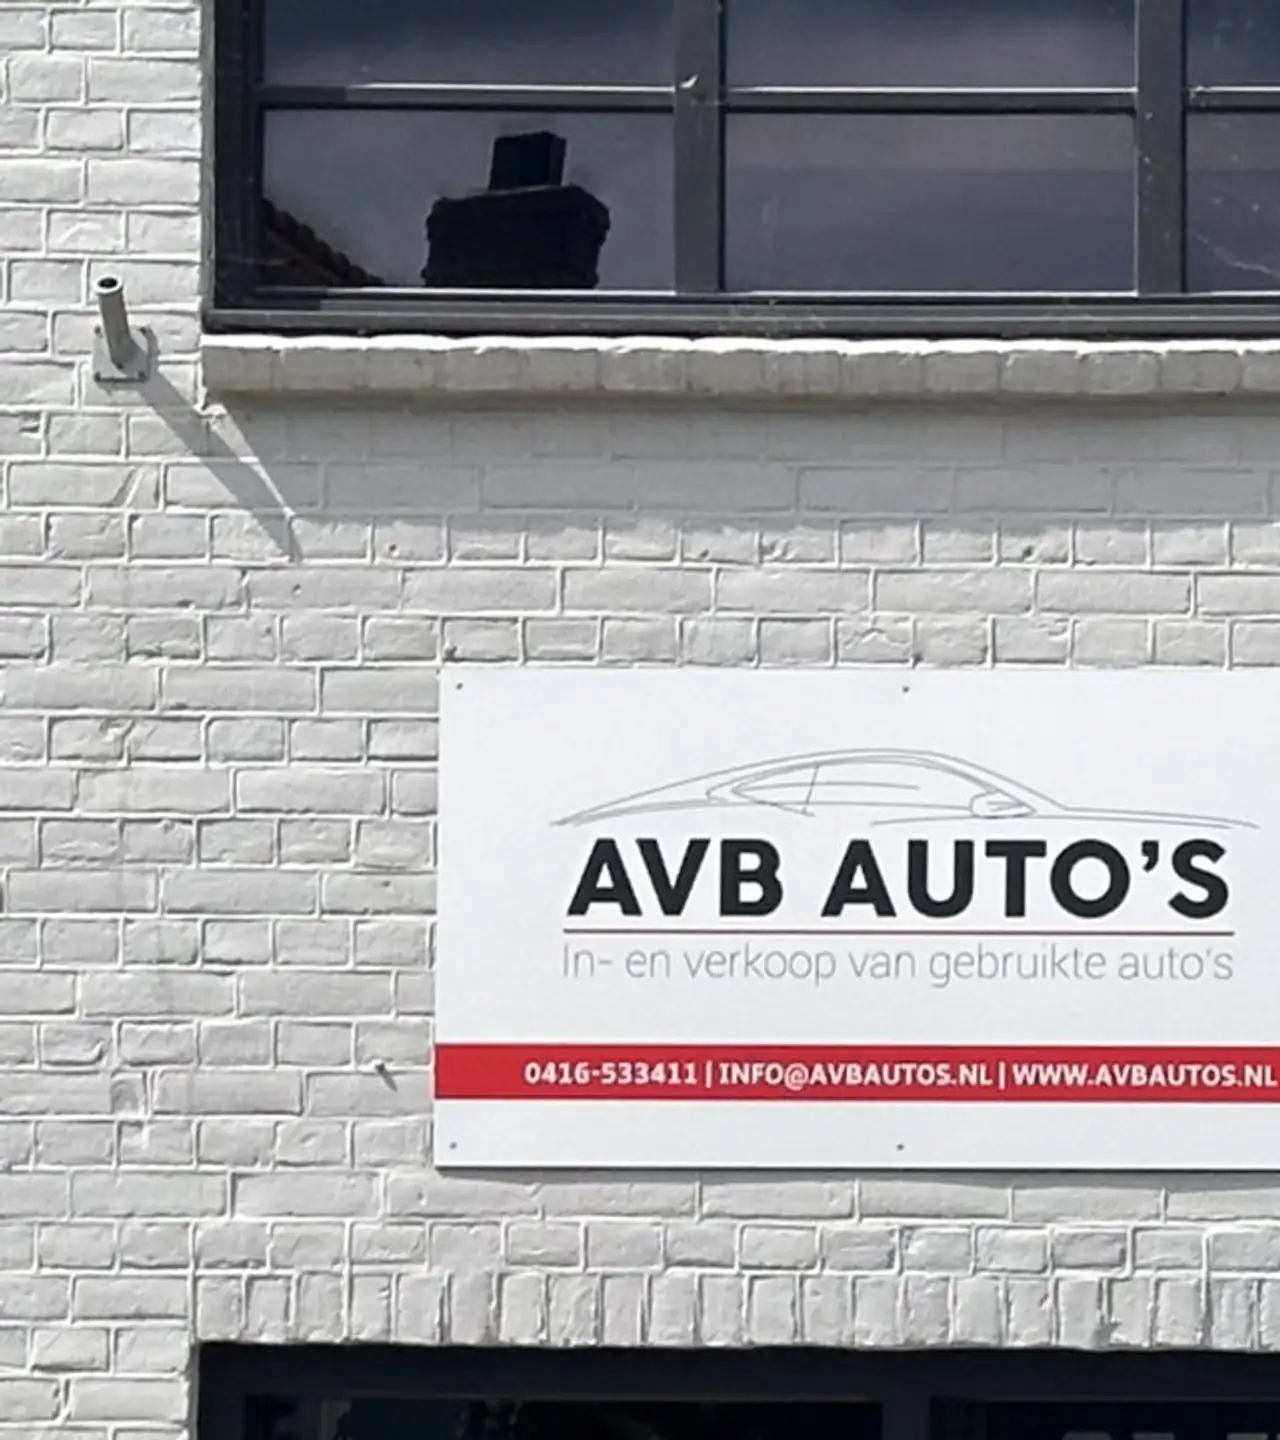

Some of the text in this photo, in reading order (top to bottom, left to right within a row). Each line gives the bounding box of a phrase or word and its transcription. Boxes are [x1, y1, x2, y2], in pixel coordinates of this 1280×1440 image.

[567, 838, 1230, 919] AVB AUTO'S
[563, 943, 1233, 988] In- en verkoop van gebruikte auto's
[524, 1061, 698, 1085] 0416-533411
[719, 1062, 993, 1090] INFO@AVBAUTOS.NL
[1012, 1063, 1278, 1087] WWW.AVBAUTOS.NL
